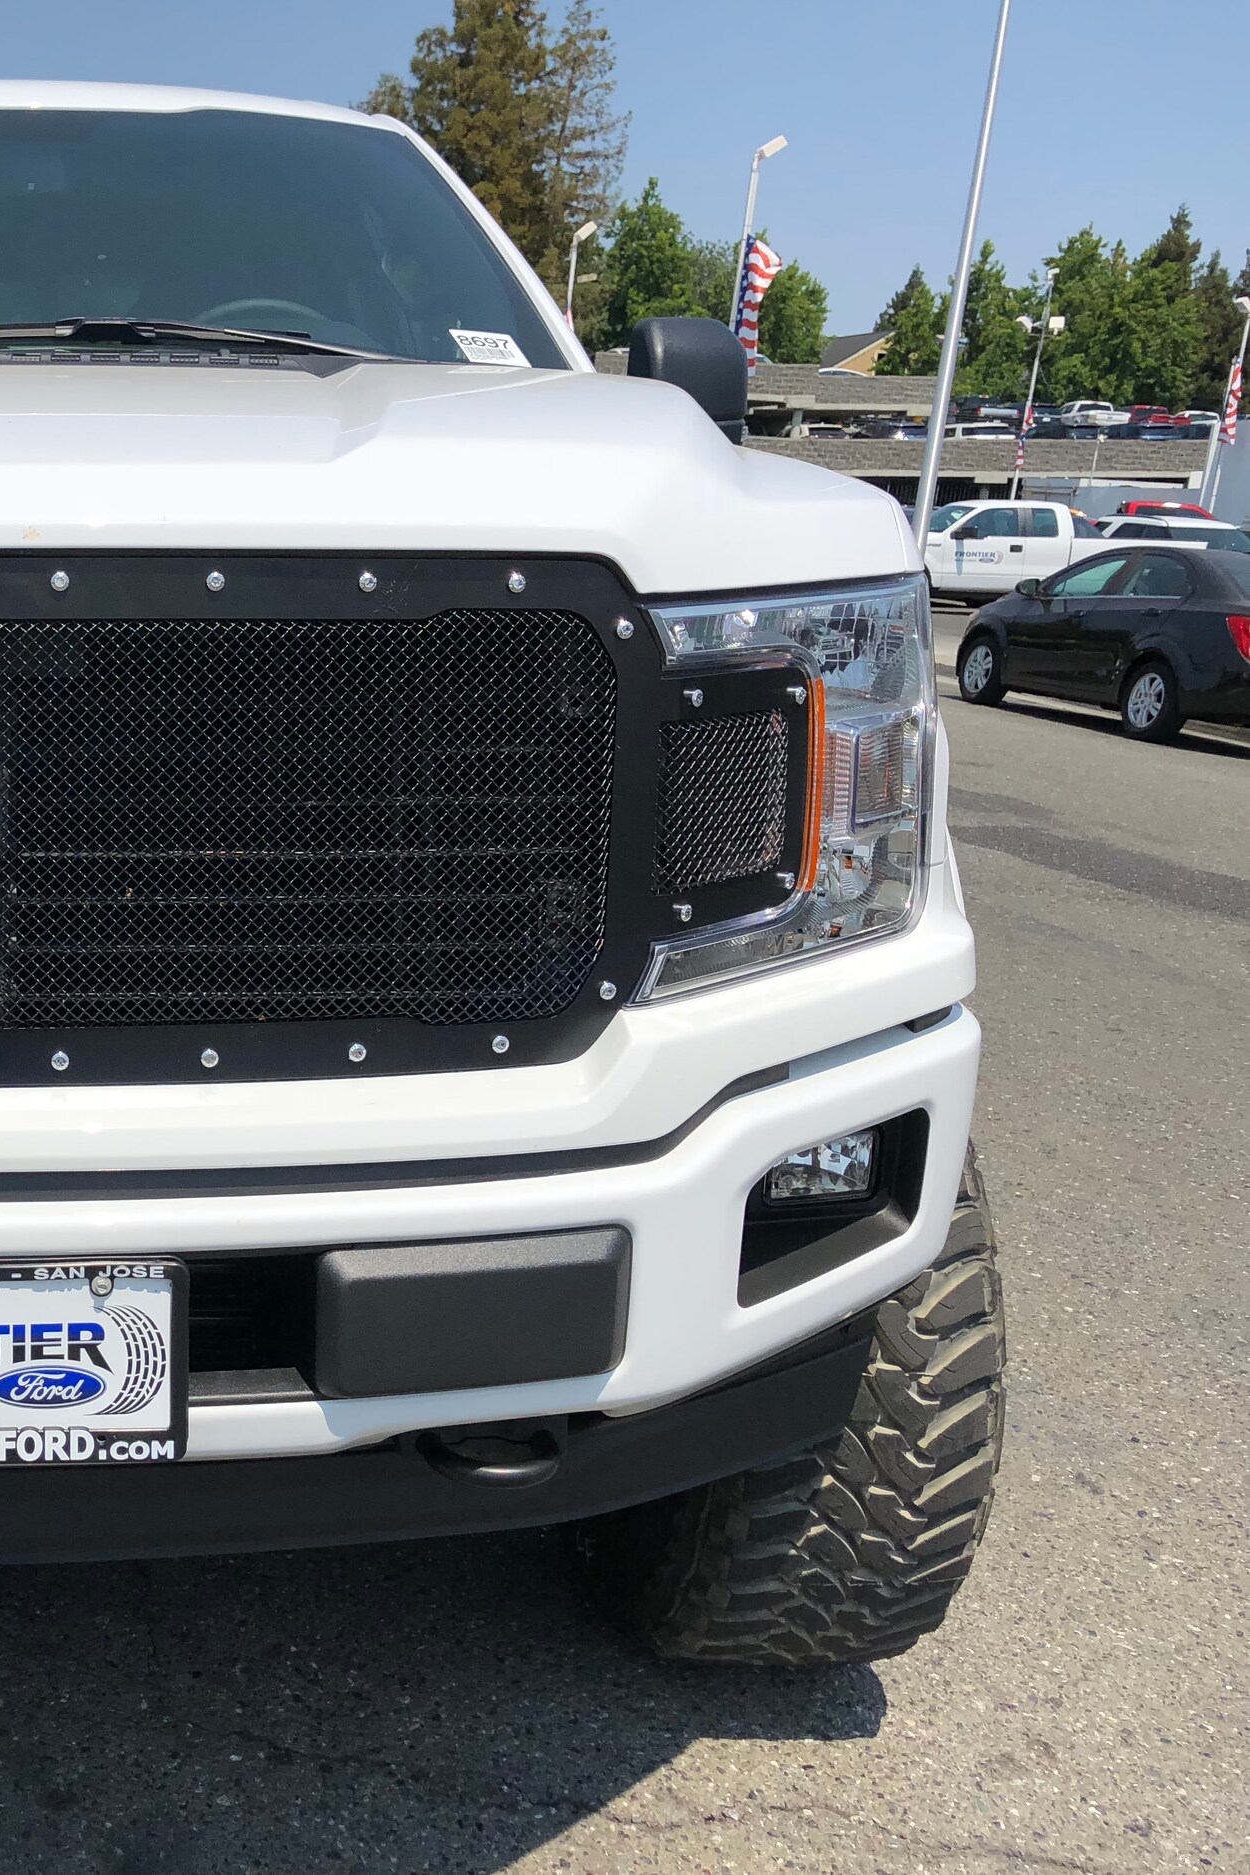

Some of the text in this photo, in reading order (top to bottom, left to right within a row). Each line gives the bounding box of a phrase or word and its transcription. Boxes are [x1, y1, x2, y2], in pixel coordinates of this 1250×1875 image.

[457, 335, 508, 350] 8697
[954, 551, 996, 559] FRONTIER
[33, 1266, 85, 1281] SAN
[98, 1265, 165, 1279] JOSE
[9, 1371, 86, 1402] Ford
